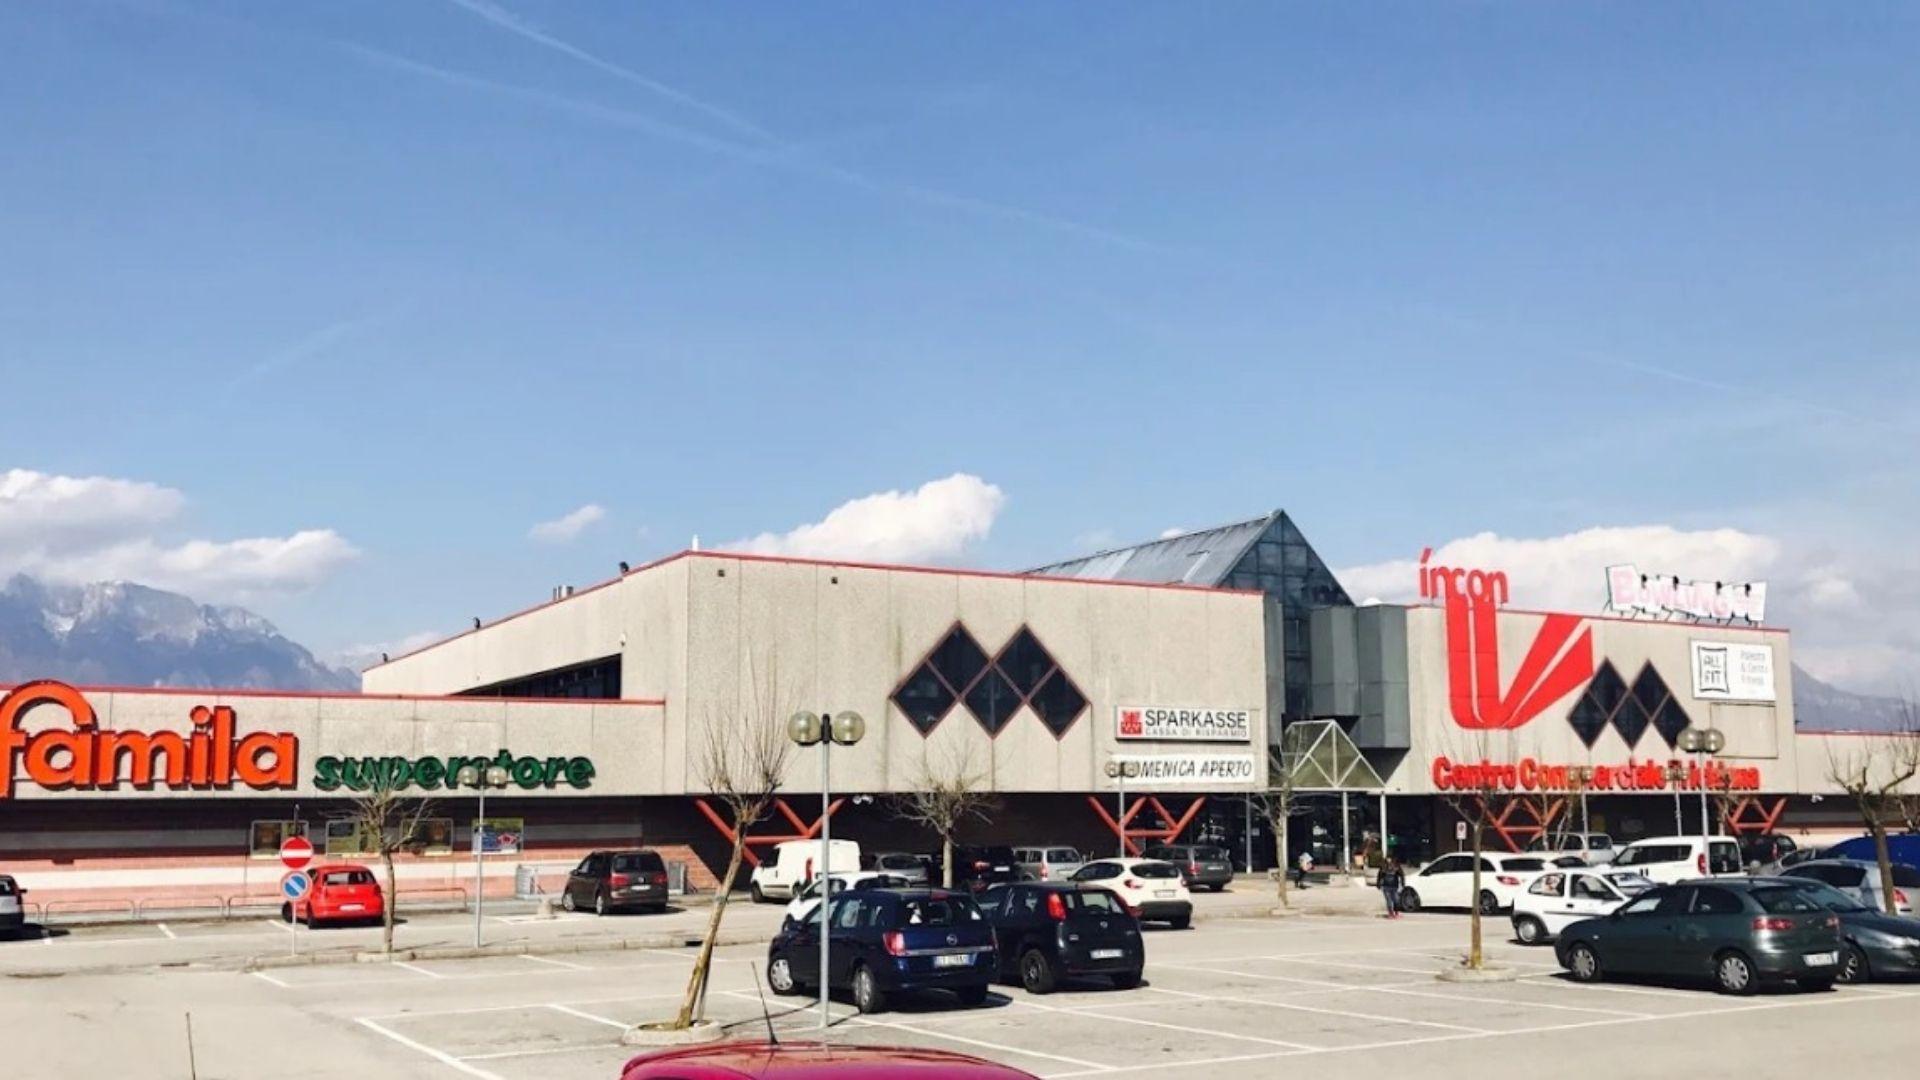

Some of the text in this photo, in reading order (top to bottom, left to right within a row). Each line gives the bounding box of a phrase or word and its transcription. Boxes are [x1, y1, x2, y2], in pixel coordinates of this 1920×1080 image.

[1145, 709, 1247, 729] SPARKASSE
[0, 679, 299, 799] famila
[1115, 759, 1252, 778] MENICA APERTO
[1433, 756, 1516, 790] Centro
[1519, 757, 1665, 791] Comerciale
